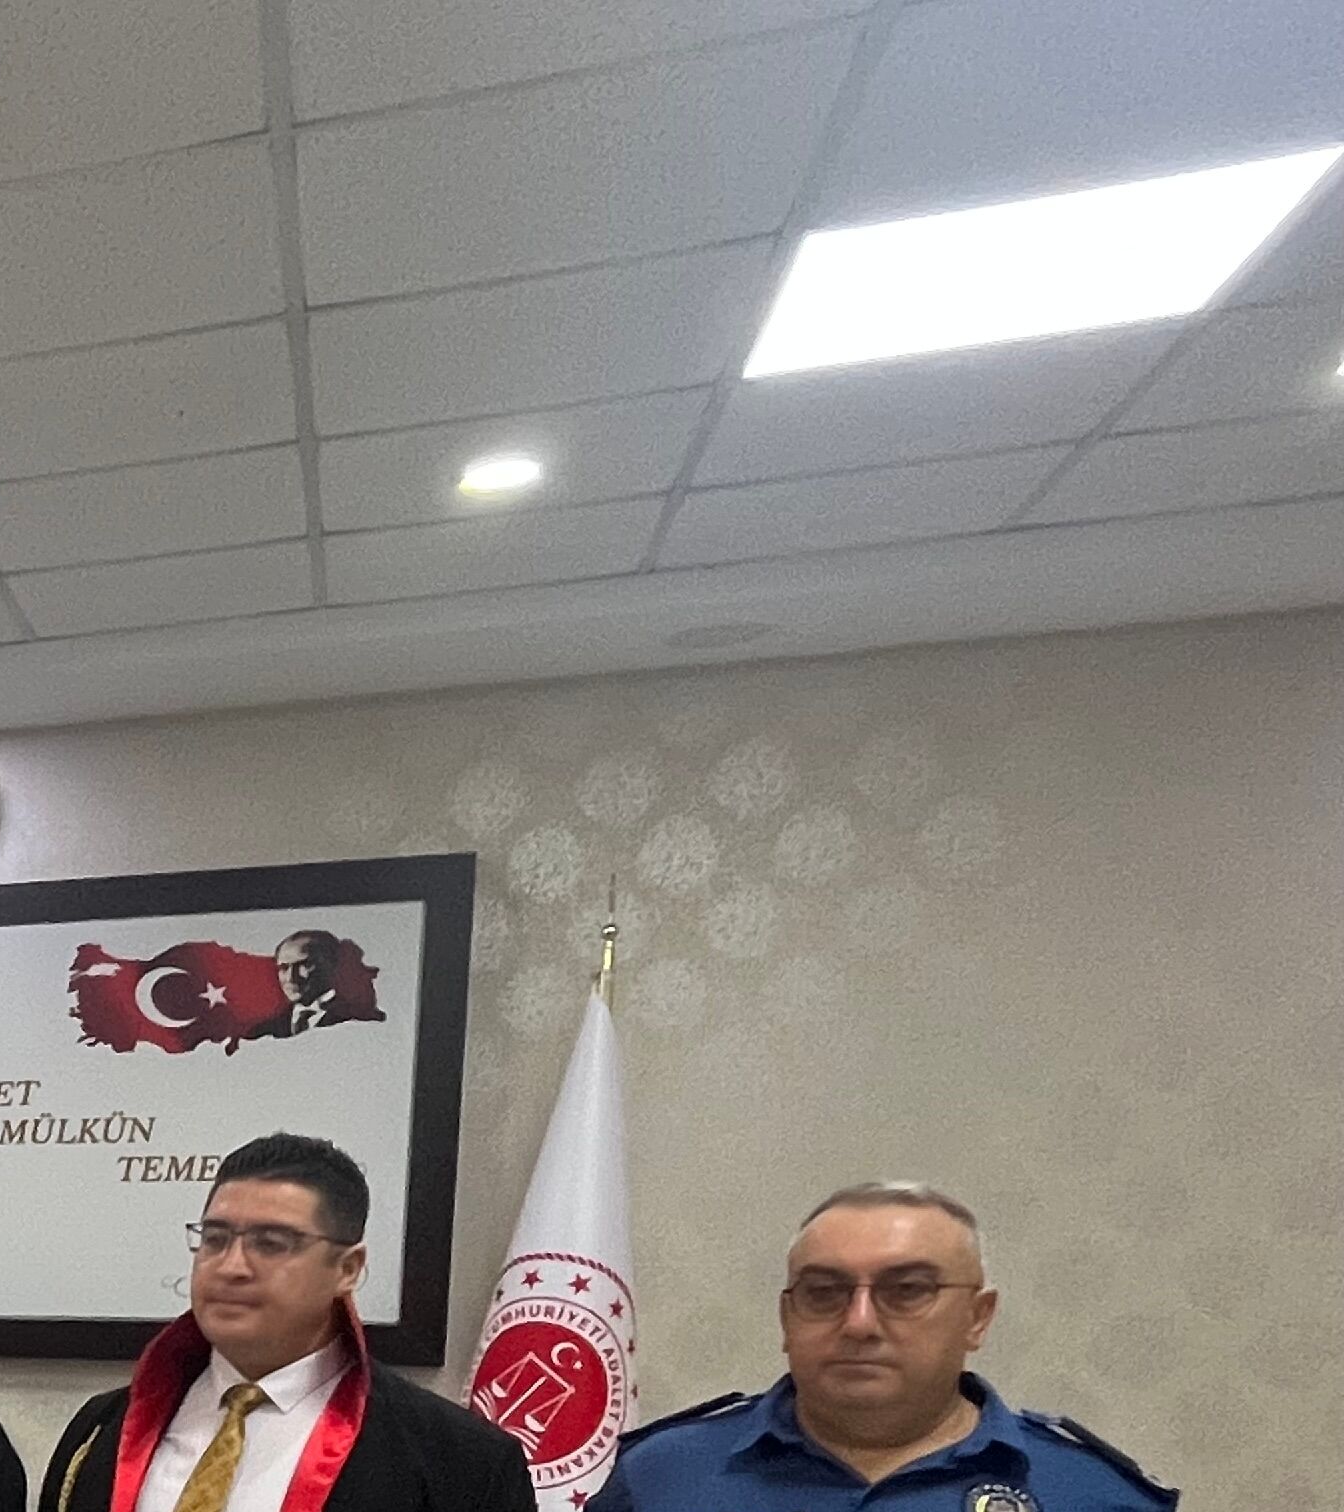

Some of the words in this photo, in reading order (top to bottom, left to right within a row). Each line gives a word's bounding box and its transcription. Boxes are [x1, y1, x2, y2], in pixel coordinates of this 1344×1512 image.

[117, 1154, 221, 1182] TEME
[602, 1348, 622, 1421] ADALET
[536, 1425, 614, 1482] BAKANLI
